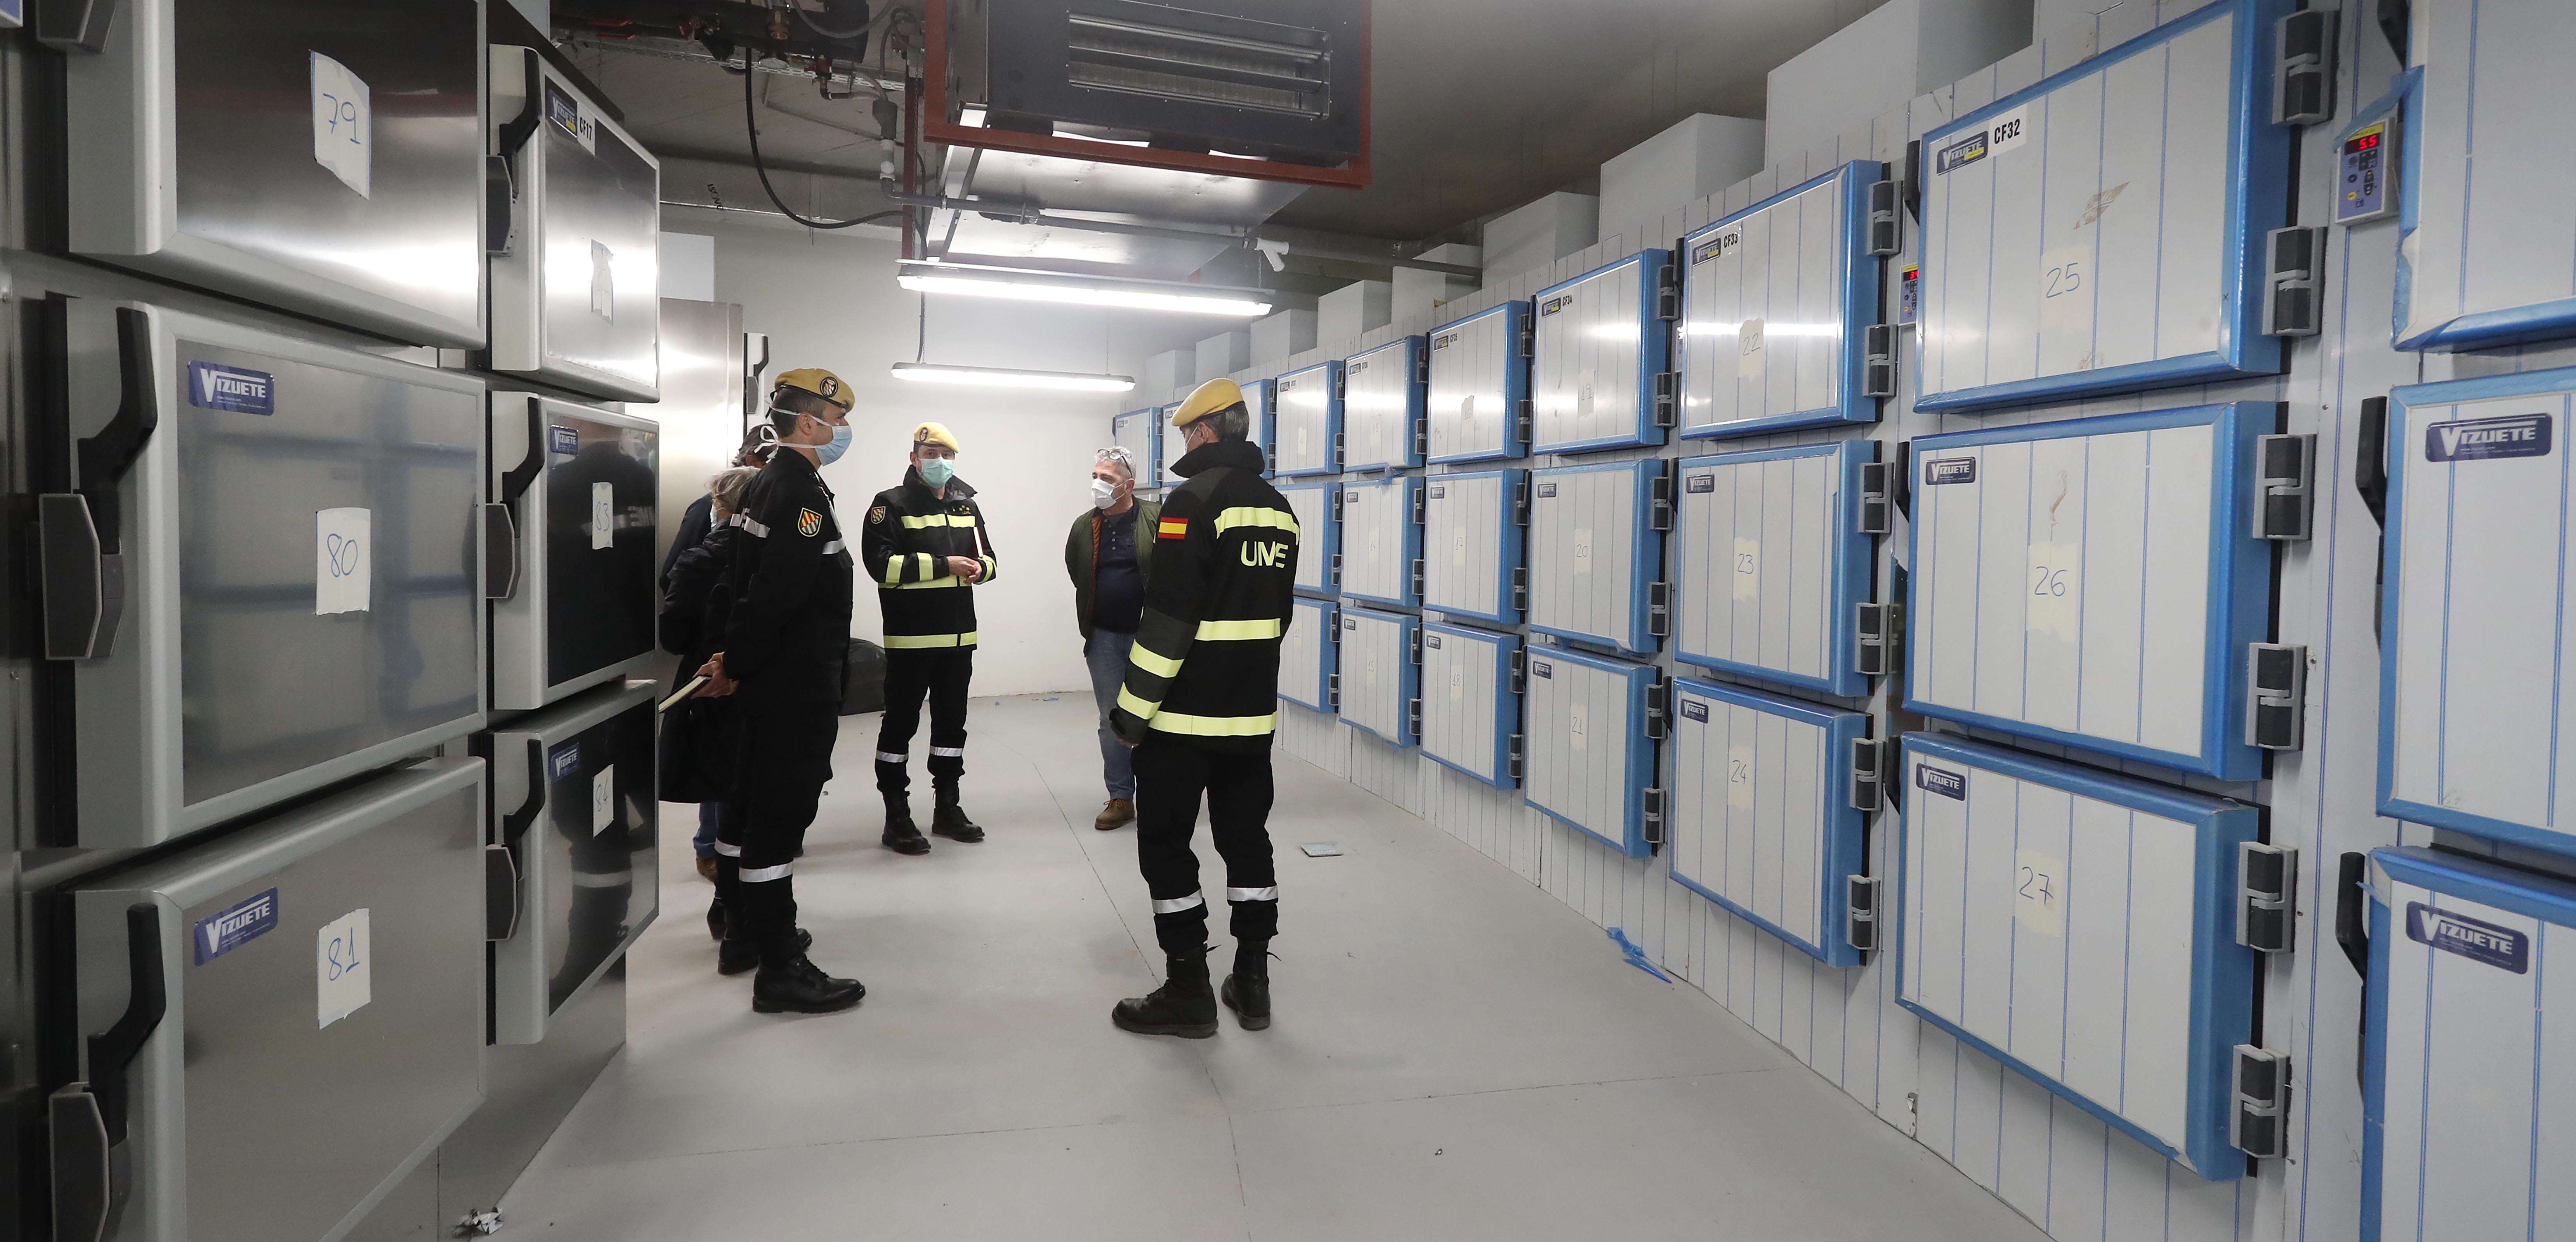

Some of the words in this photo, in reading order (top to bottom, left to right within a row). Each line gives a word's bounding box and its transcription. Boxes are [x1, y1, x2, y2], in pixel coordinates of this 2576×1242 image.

[323, 93, 361, 145] 79
[580, 117, 592, 140] CF17
[1994, 118, 2020, 144] CF32
[1724, 232, 1738, 248] CF33
[2046, 262, 2080, 298] 25
[1563, 295, 1572, 306] CF34
[1743, 333, 1761, 356] 22
[200, 368, 266, 403] VIZUETE
[1581, 383, 1592, 401] 19
[2440, 420, 2537, 457] VIZUETE
[1689, 476, 1711, 491] VIZUETE
[1931, 461, 1970, 482] VIZUETE
[596, 501, 610, 532] 83
[327, 534, 358, 577] 80
[1241, 541, 1288, 569] UME
[1576, 544, 1588, 558] 20
[1737, 553, 1754, 574] 23
[2034, 566, 2067, 596] 26
[1452, 672, 1461, 686] 18
[1684, 701, 1706, 716] VIZUETE
[1572, 717, 1583, 735] 21
[1731, 760, 1746, 784] 24
[1921, 767, 1960, 789] VIZUETE
[2019, 867, 2053, 905] 27
[206, 896, 270, 953] VIZUETE
[2420, 909, 2514, 955] VIZUETE
[328, 927, 360, 981] 81
